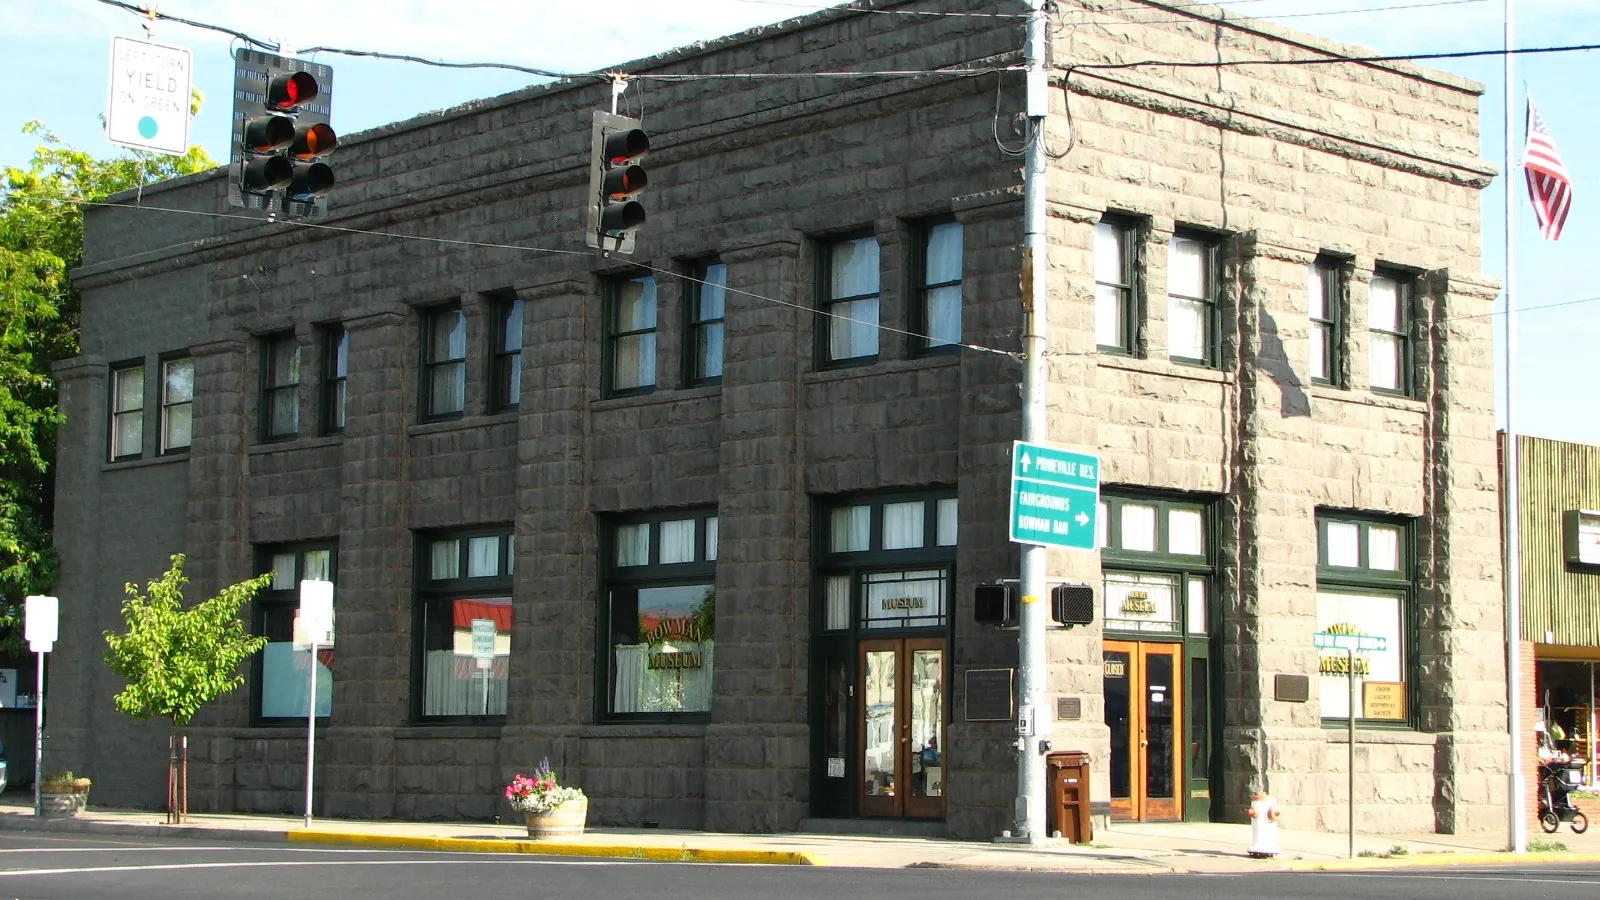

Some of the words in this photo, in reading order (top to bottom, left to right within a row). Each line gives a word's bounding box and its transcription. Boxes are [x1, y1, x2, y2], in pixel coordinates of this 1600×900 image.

[126, 68, 177, 92] YIELD
[120, 91, 135, 104] ON
[143, 95, 180, 112] GREEN
[1036, 456, 1077, 477] PRINEVILLE
[1019, 491, 1070, 512] FAIRGROUNDS
[1018, 514, 1050, 533] BOWMAN
[881, 597, 924, 610] MUSEUM
[1122, 600, 1157, 614] MUSEUM
[646, 618, 703, 644] BOWMAN
[648, 651, 702, 670] MUSEUM
[1104, 664, 1125, 676] CLOSED
